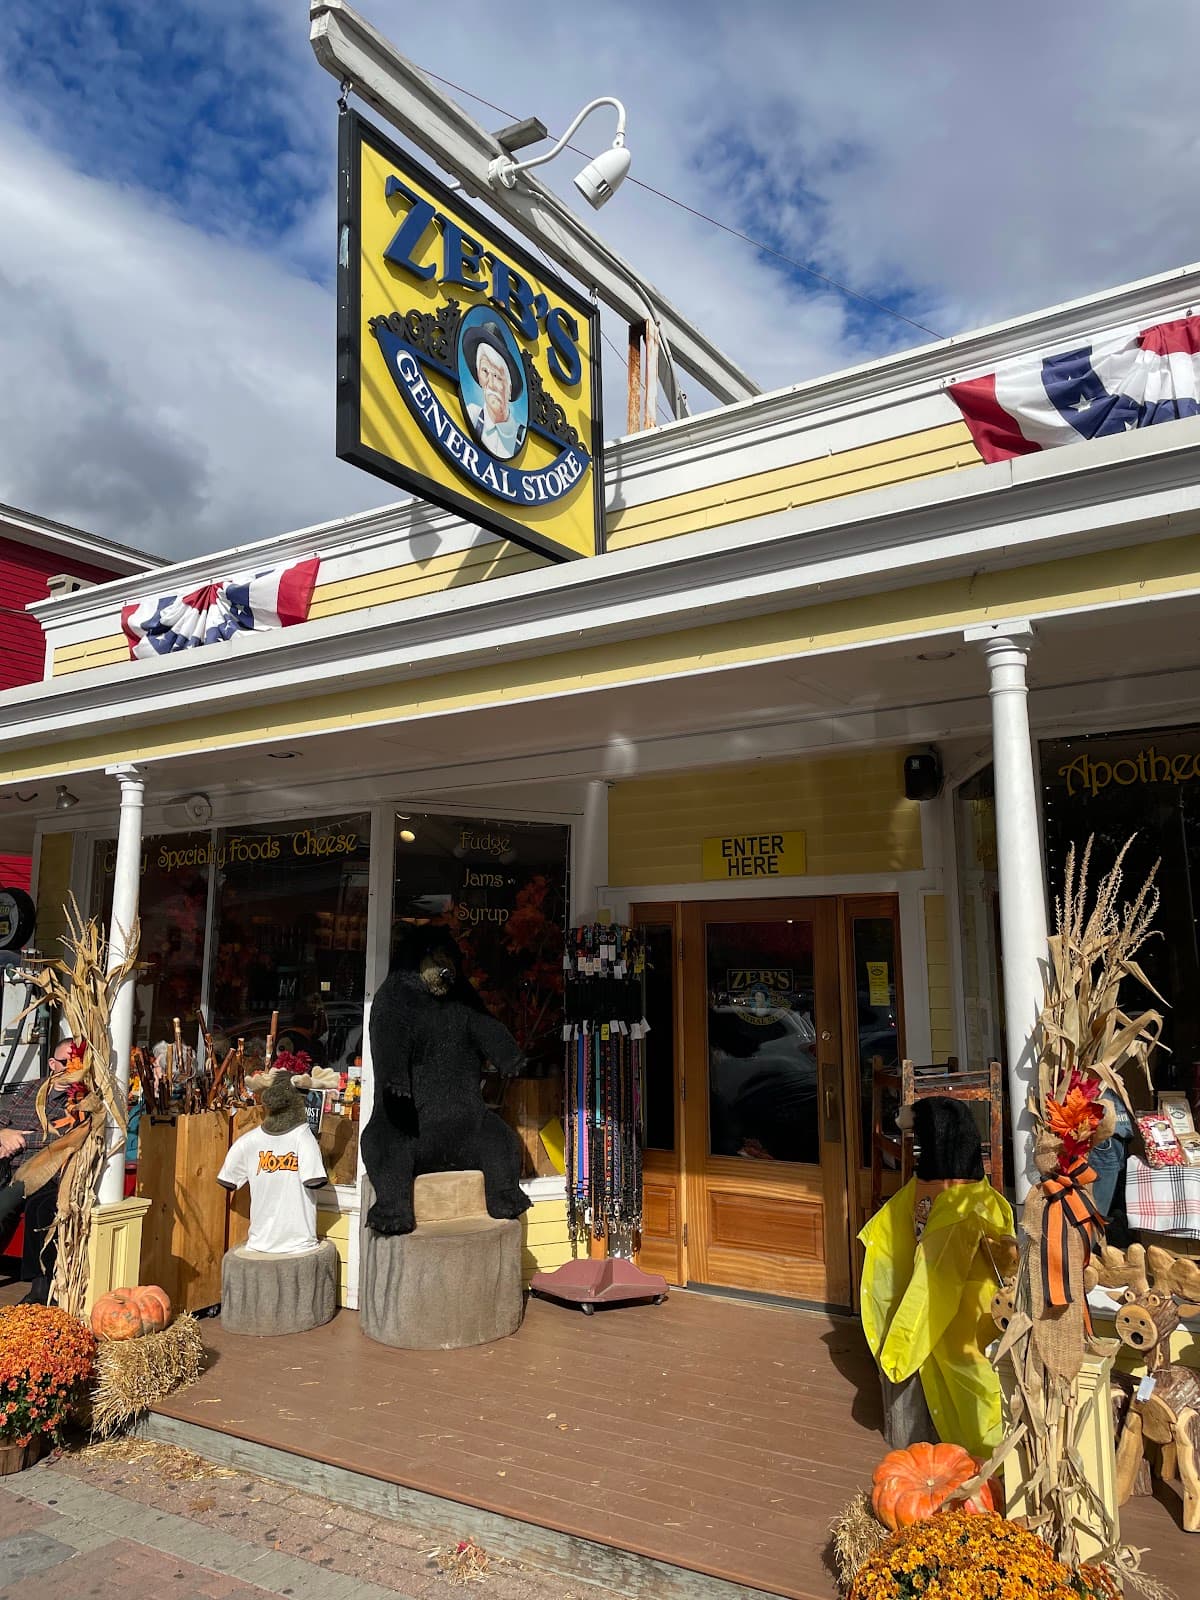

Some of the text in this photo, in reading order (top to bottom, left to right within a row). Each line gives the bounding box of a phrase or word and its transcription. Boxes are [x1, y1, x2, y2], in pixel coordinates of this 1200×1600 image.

[383, 175, 581, 387] ZEB'S
[397, 350, 582, 501] GENERAL STORE
[157, 841, 227, 872] Specialty
[230, 836, 281, 862] Foods
[293, 829, 358, 856] Cheese
[460, 831, 512, 856] Fudge
[722, 835, 784, 857] ENTER
[728, 855, 779, 876] HERE
[462, 868, 504, 888] Jams
[457, 902, 509, 926] Syrup
[731, 970, 790, 989] ZEB'S
[257, 1151, 298, 1175] MOXIE
